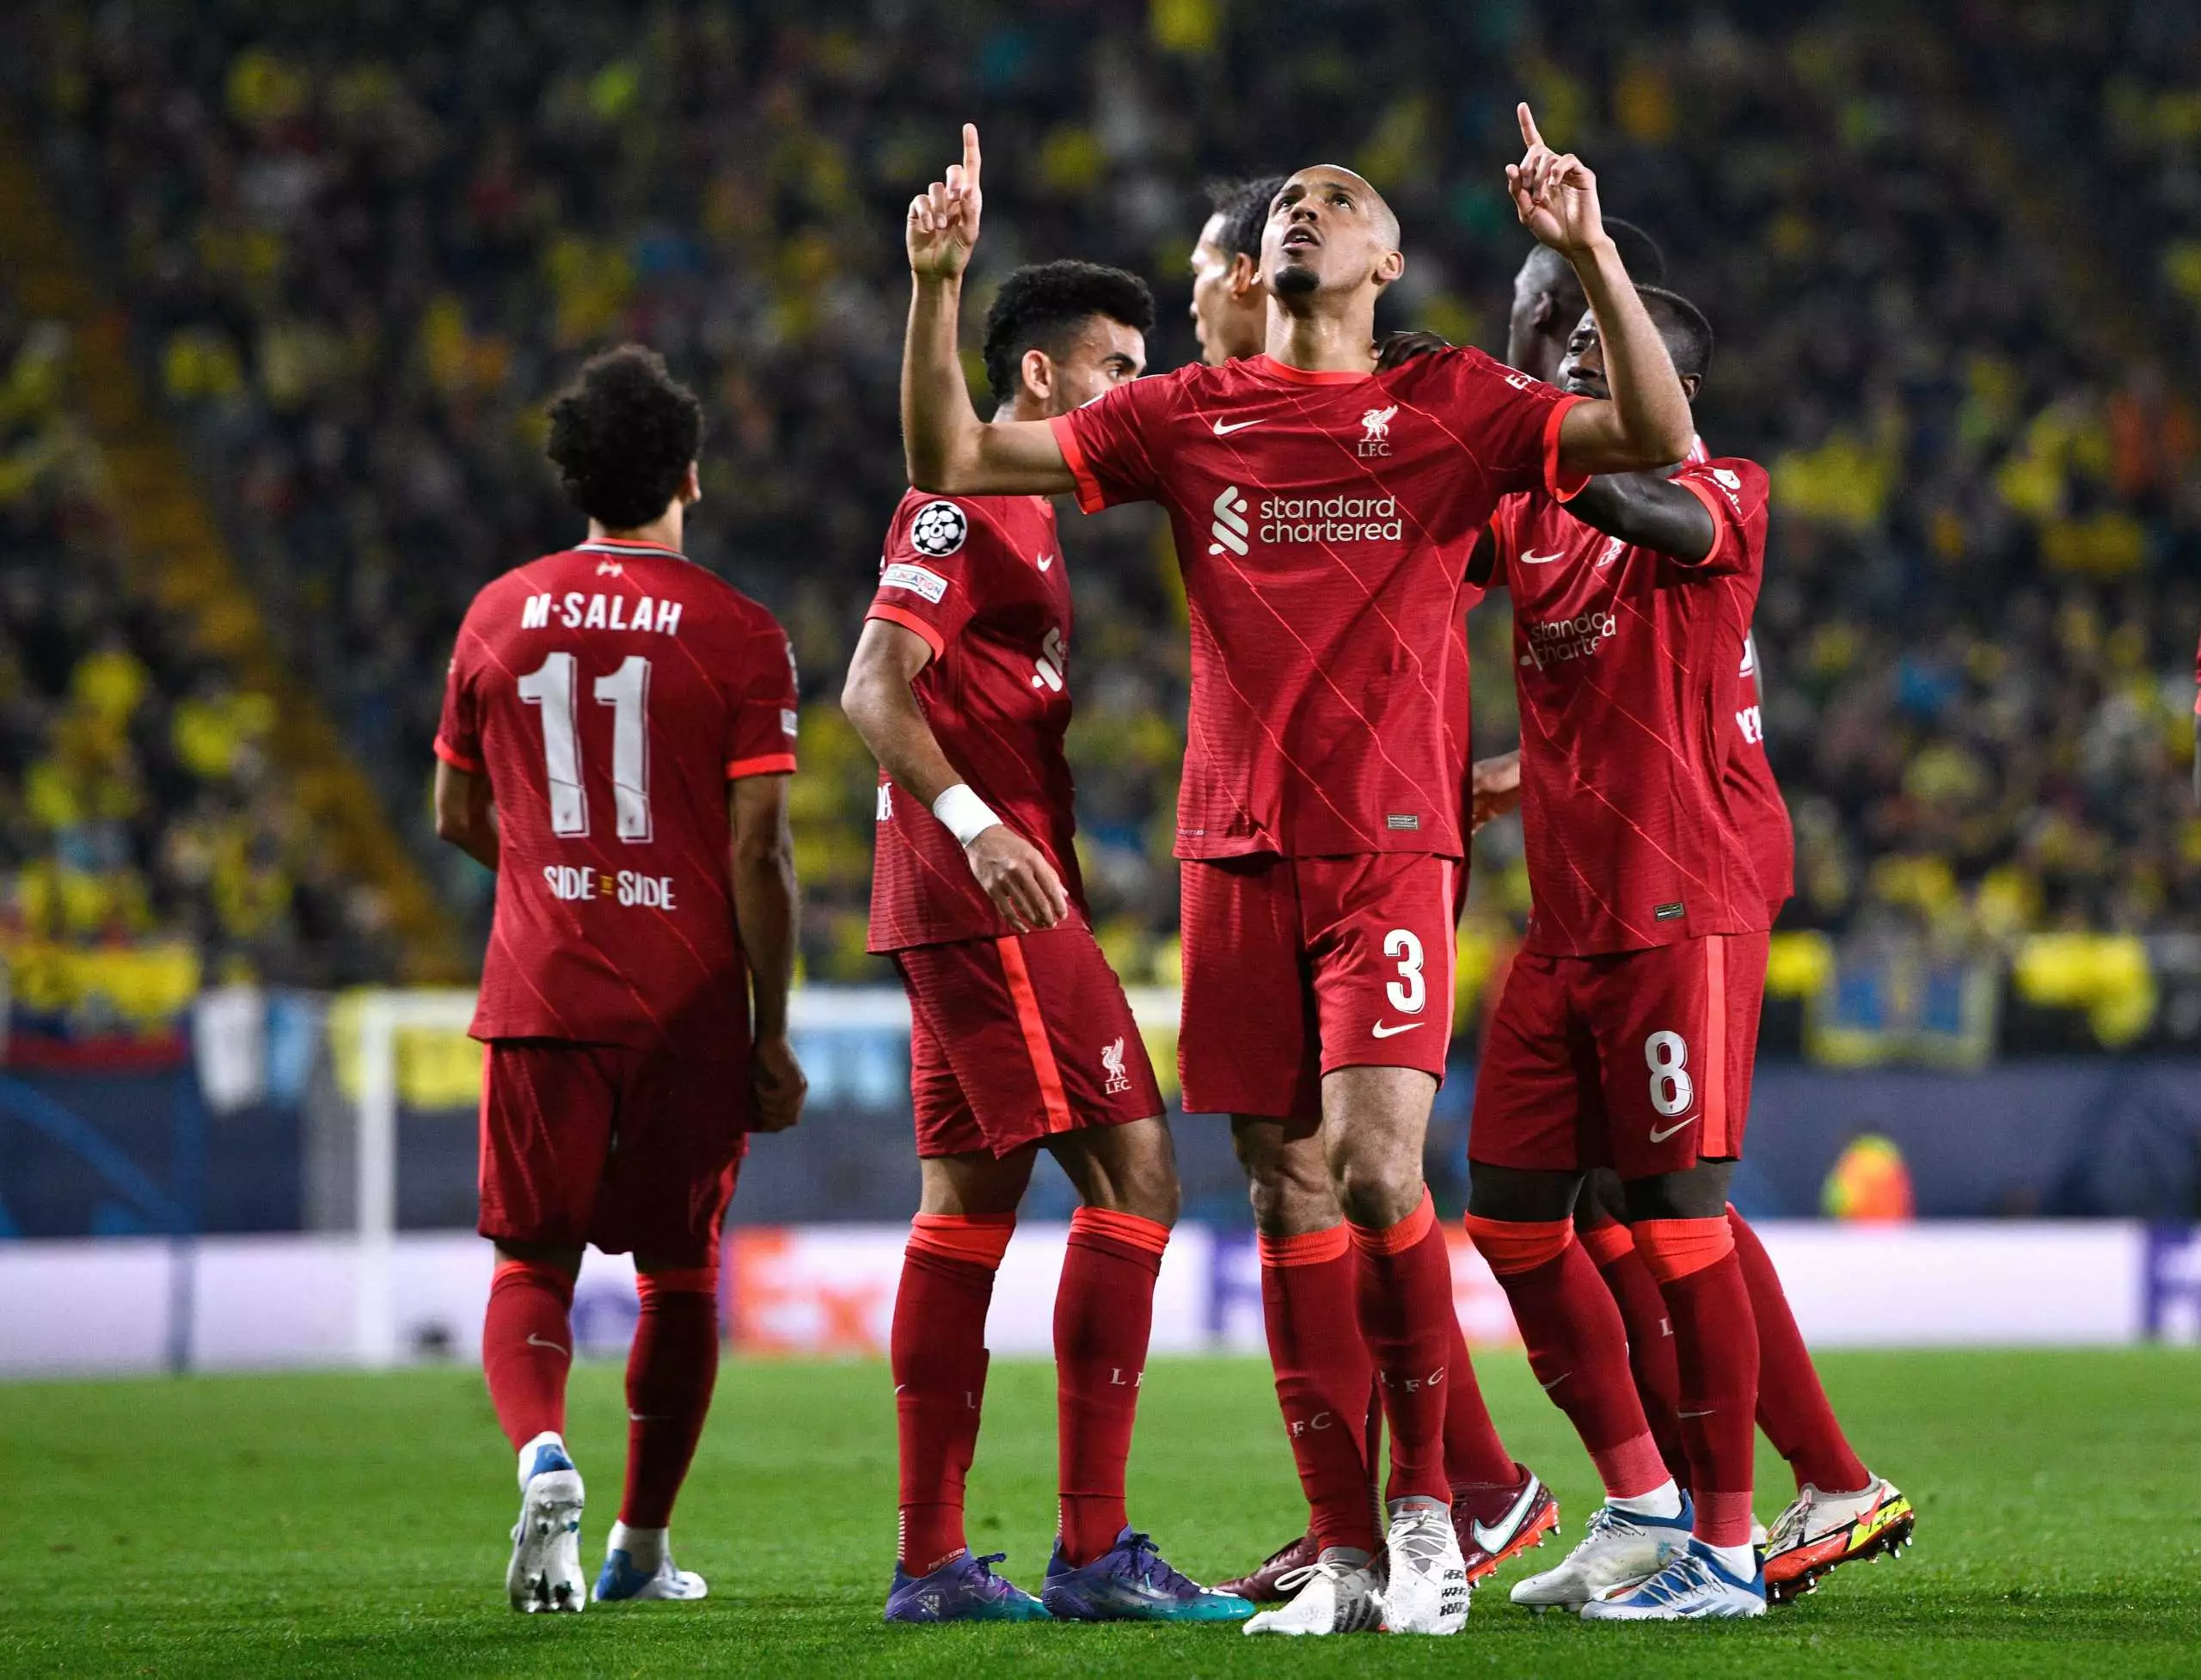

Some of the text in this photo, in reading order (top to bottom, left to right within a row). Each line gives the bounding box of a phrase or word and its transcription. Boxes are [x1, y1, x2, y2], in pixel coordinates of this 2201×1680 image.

[1259, 518, 1402, 544] chartered
[1260, 495, 1396, 519] standard
[518, 652, 653, 843] 11
[543, 865, 597, 900] SIDE
[617, 869, 677, 911] SIDE
[1384, 929, 1426, 1015] 3
[1645, 1030, 1694, 1117] 8
